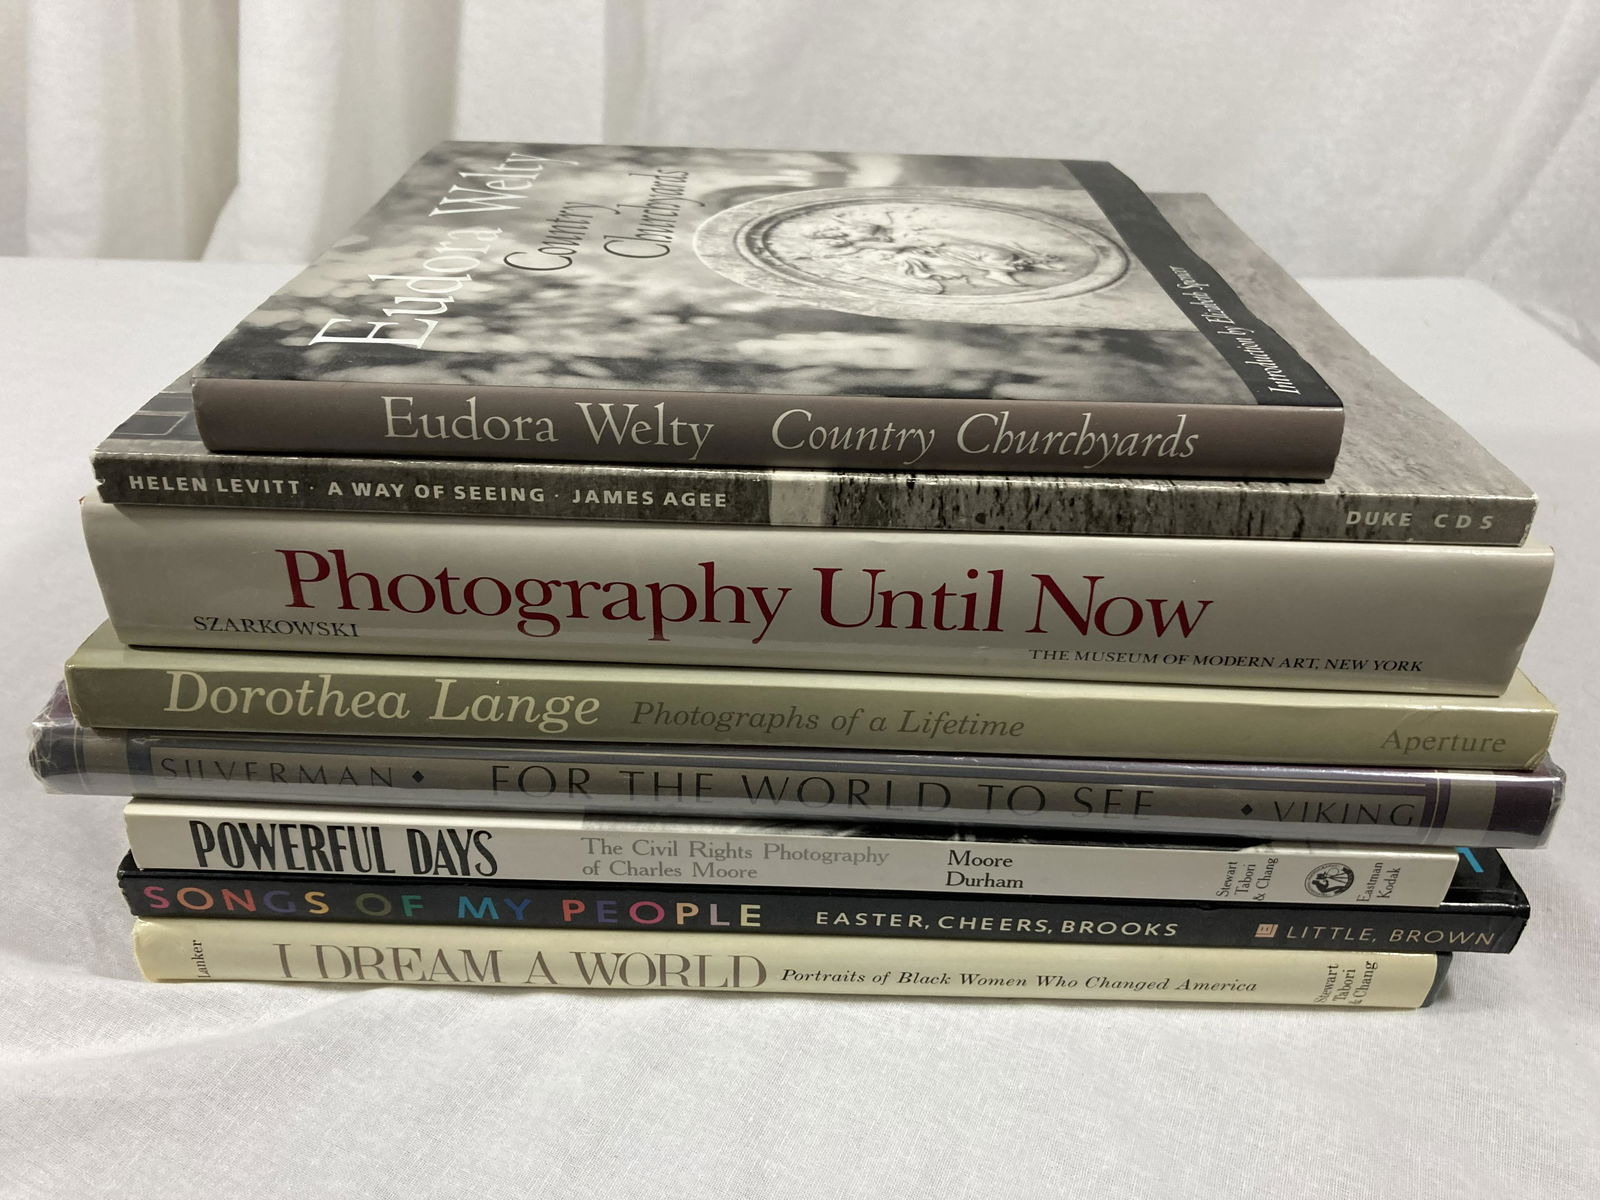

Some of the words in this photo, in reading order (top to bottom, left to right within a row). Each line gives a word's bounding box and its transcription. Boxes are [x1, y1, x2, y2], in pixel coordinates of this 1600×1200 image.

[603, 169, 705, 258] Churchyards
[308, 227, 503, 348] Eudora
[428, 152, 579, 217] Welty
[504, 201, 621, 271] Country
[1217, 325, 1255, 335] by
[1237, 337, 1301, 395] Introduction
[381, 396, 559, 442] Eudora
[575, 401, 714, 461] Welty
[771, 408, 935, 465] Country
[957, 411, 1199, 468] Churchyards
[128, 475, 207, 491] HELEN
[216, 478, 300, 495] LEVITT
[327, 481, 343, 496] A
[351, 482, 404, 498] WAY
[414, 484, 445, 499] OF
[454, 485, 545, 502] SEEING
[572, 489, 654, 505] JAMES
[663, 492, 727, 507] AGEE
[1346, 511, 1412, 526] DUKE
[275, 548, 793, 644] Photography
[813, 567, 1004, 632] Until
[1025, 574, 1214, 638] Now
[193, 616, 360, 637] SZARKOWSKI
[1028, 649, 1069, 661] THE
[1074, 650, 1158, 665] MUSEUM
[1163, 653, 1190, 666] OF
[1192, 655, 1275, 669] MODERN
[1324, 658, 1369, 671] NEW
[1371, 659, 1423, 673] YORK
[163, 670, 410, 720] Dorothea
[428, 677, 600, 734] Lange
[630, 701, 820, 733] Photographs
[831, 708, 865, 737] of
[869, 715, 887, 732] a
[897, 709, 1025, 739] Lifetime
[1380, 729, 1507, 755] Aperture
[160, 757, 393, 788] SILVERMAN
[491, 765, 593, 799] FOR
[619, 770, 713, 803] THE
[740, 774, 950, 813] WORLD
[977, 783, 1046, 816] TO
[1072, 786, 1154, 820] SEE
[1274, 800, 1416, 827] VIKING
[189, 820, 396, 875] POWERFUL
[406, 827, 498, 877] DAYS
[581, 837, 623, 856] The
[632, 837, 678, 858] Civil
[689, 840, 753, 861] Rights
[763, 842, 890, 866] Photography
[947, 849, 1013, 868] Moore
[582, 860, 600, 876] of
[609, 860, 682, 878] Charles
[692, 861, 758, 879] Moore
[945, 871, 1024, 889] Durham
[1215, 861, 1238, 897] Stewart
[1234, 863, 1256, 895] Tabori
[1255, 857, 1279, 890] Chang
[1356, 861, 1383, 902] Eastman
[1376, 866, 1401, 899] Kodak
[143, 886, 330, 915] SONGS
[355, 893, 424, 917] OF
[458, 896, 531, 920] MY
[562, 899, 761, 928] PEOPLE
[1252, 891, 1266, 901] &
[815, 911, 930, 931] EASTER,
[938, 915, 1052, 935] CHEERS,
[1061, 919, 1179, 937] BROOKS
[1286, 925, 1377, 944] LITTLE,
[1389, 928, 1495, 946] BROWN
[191, 939, 211, 978] Lanker
[272, 943, 301, 979] I
[311, 943, 507, 984] DREAM
[523, 950, 559, 985] A
[569, 951, 767, 988] WORLD
[780, 967, 866, 983] Portraits
[872, 968, 890, 986] of
[899, 970, 951, 986] Black
[959, 973, 1027, 988] Women
[1035, 974, 1078, 989] Who
[1085, 975, 1169, 993] Changed
[1175, 977, 1258, 992] America
[1313, 963, 1339, 1003] Stewart
[1332, 969, 1356, 1001] Tabori
[1352, 961, 1378, 998] Chang
